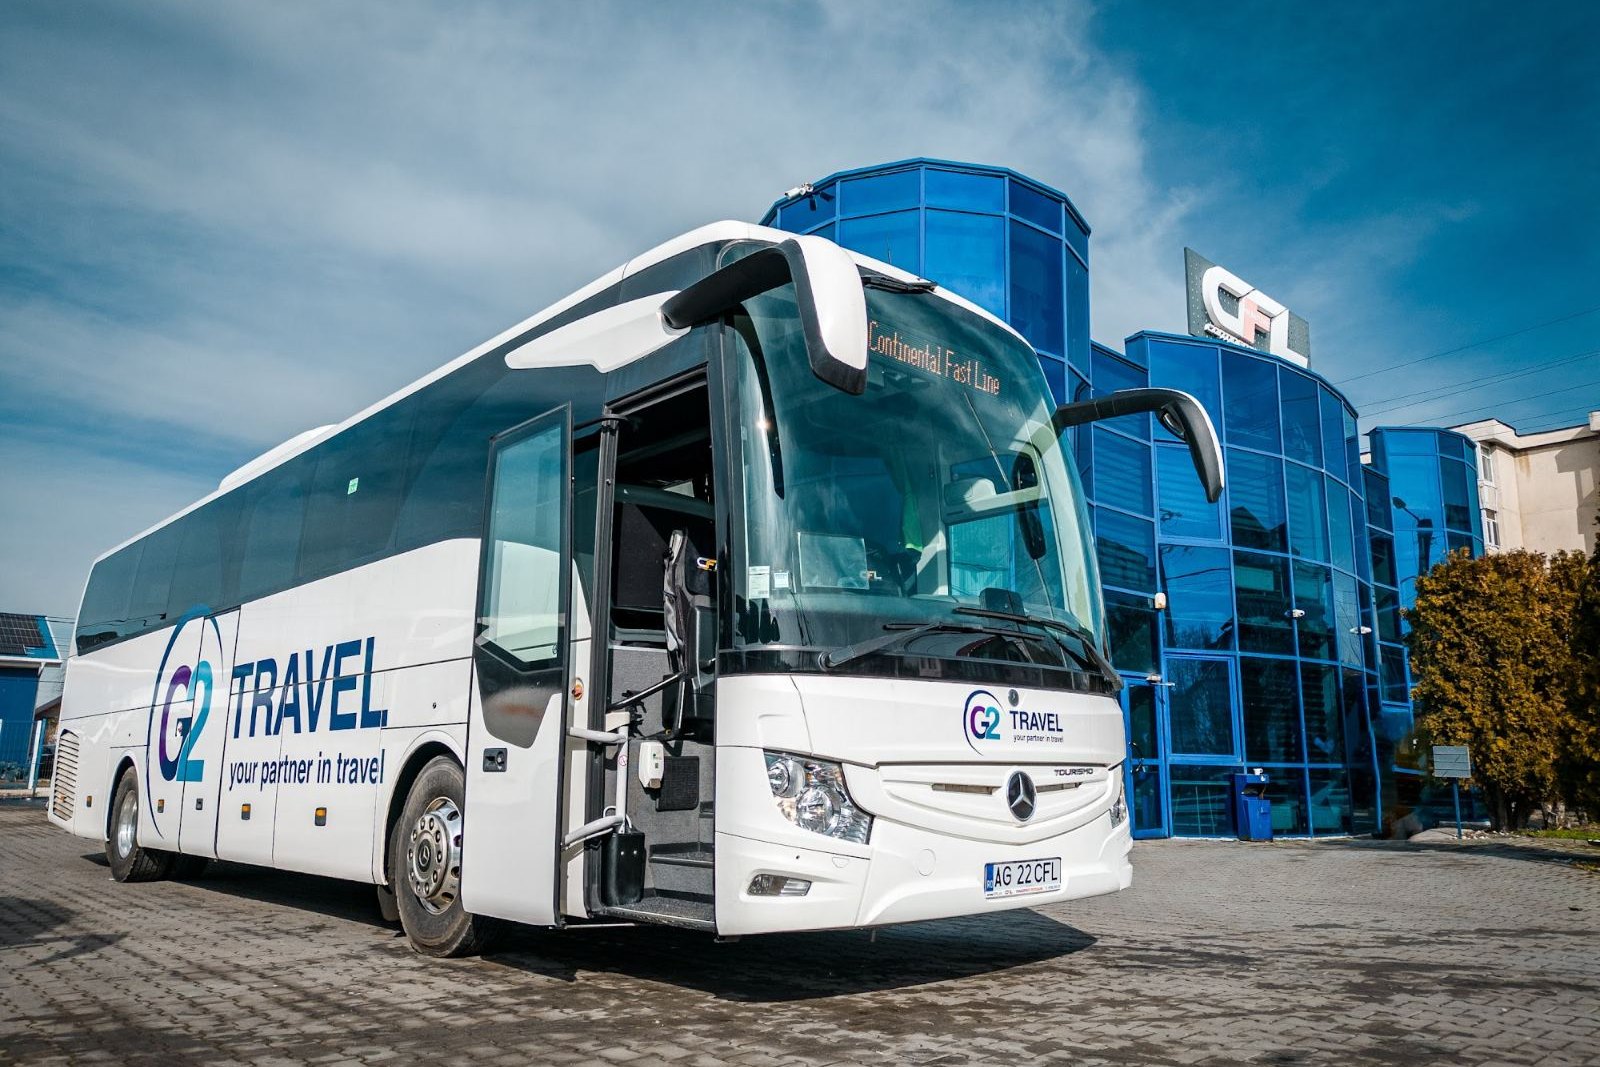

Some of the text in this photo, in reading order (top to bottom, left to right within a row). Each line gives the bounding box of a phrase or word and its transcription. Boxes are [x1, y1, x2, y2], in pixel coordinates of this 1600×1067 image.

[1202, 266, 1308, 368] CFL
[868, 320, 1000, 395] Continental Fast Line
[232, 636, 388, 739] TRAVEL
[158, 660, 213, 782] G2
[970, 705, 1001, 740] G2
[1009, 710, 1064, 733] TRAVEL
[1013, 734, 1026, 743] your
[1027, 734, 1045, 744] partner
[1051, 735, 1064, 743] travel
[229, 749, 386, 792] your partner in travel
[1054, 768, 1094, 777] TOURISMO
[994, 861, 1058, 887] AG 22 CFL
